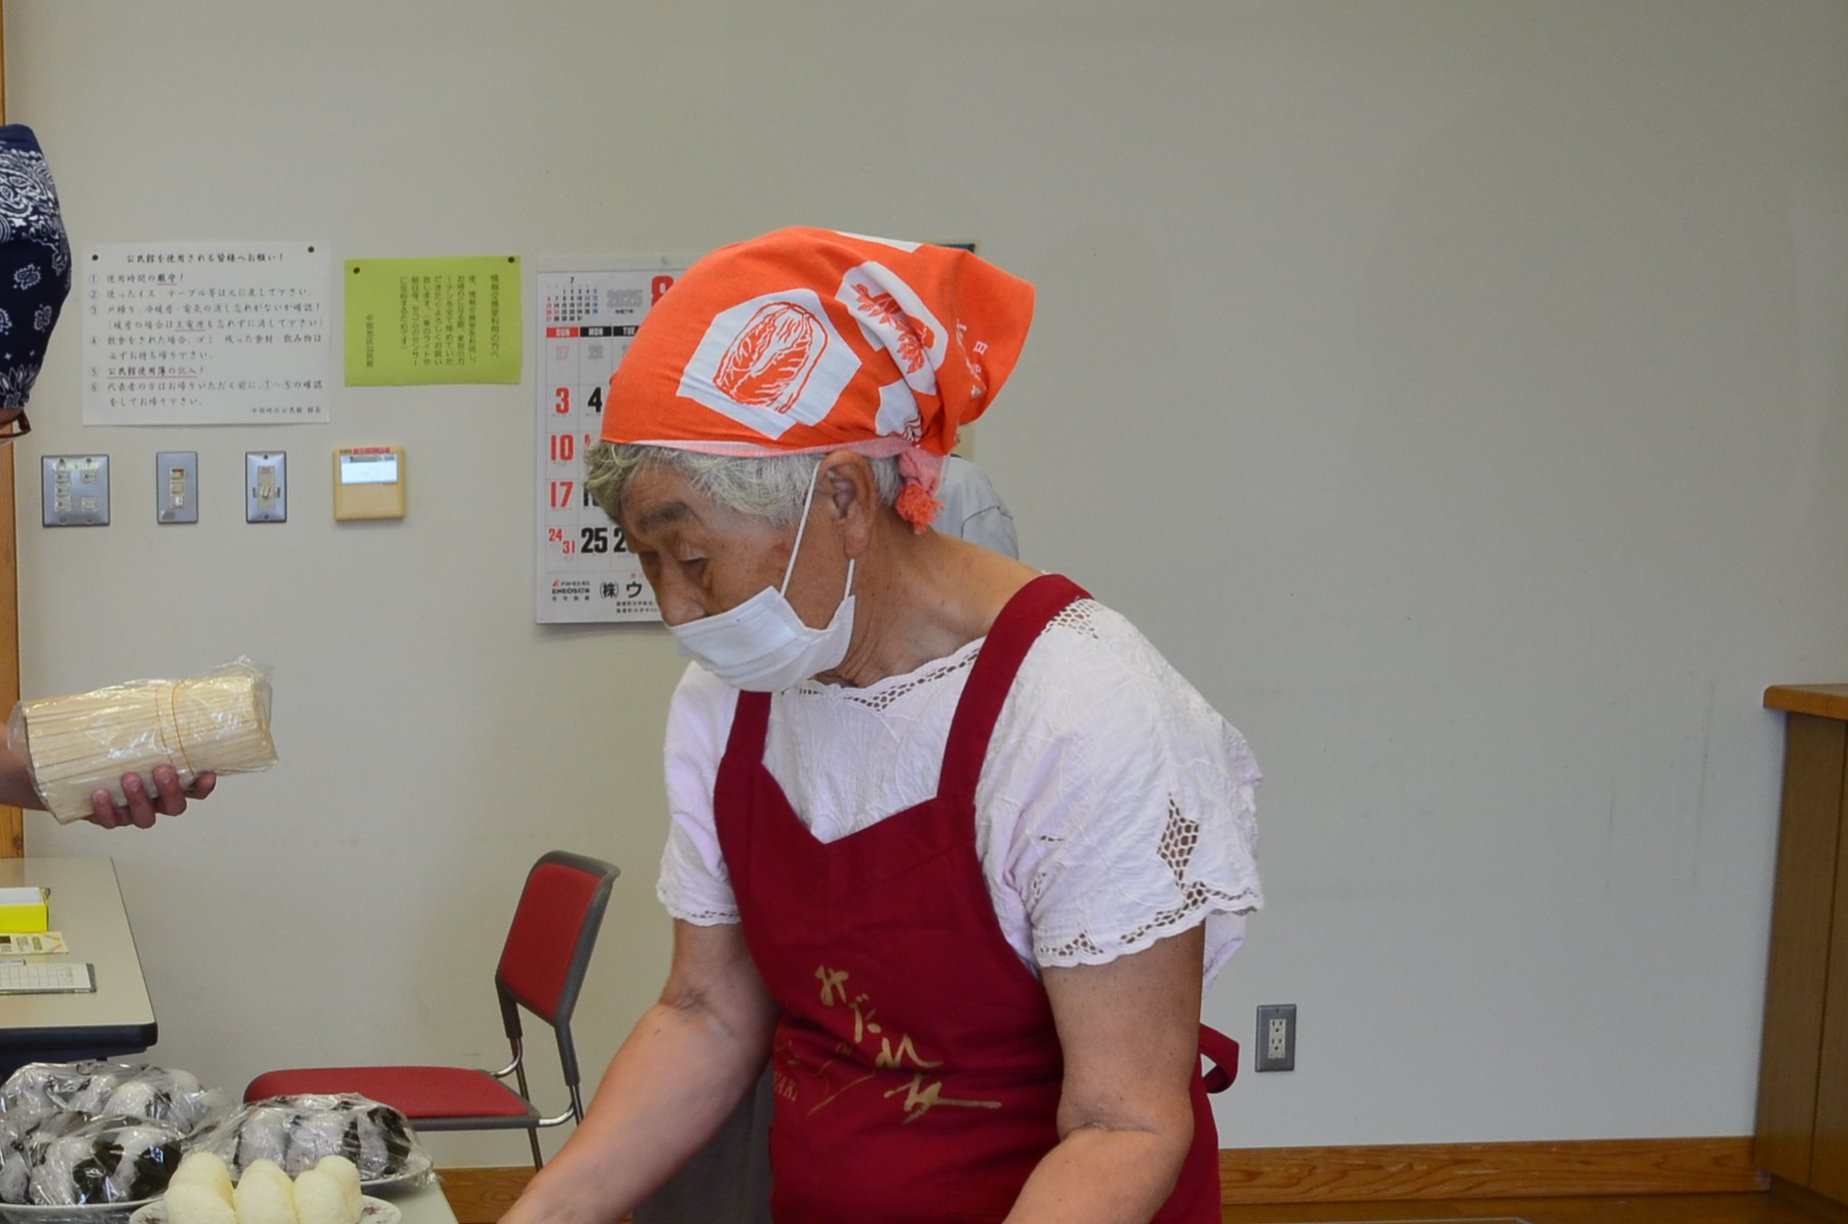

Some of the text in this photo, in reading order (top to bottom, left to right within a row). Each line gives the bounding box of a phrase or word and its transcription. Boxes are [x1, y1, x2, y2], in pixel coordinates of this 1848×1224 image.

[606, 289, 643, 307] 2025
[556, 328, 570, 336] SUN
[588, 328, 603, 336] MON
[555, 387, 602, 414] 3 4
[551, 434, 574, 461] 10
[550, 482, 573, 507] 17
[548, 528, 563, 542] 24
[581, 528, 607, 553] 25
[562, 540, 575, 554] 31
